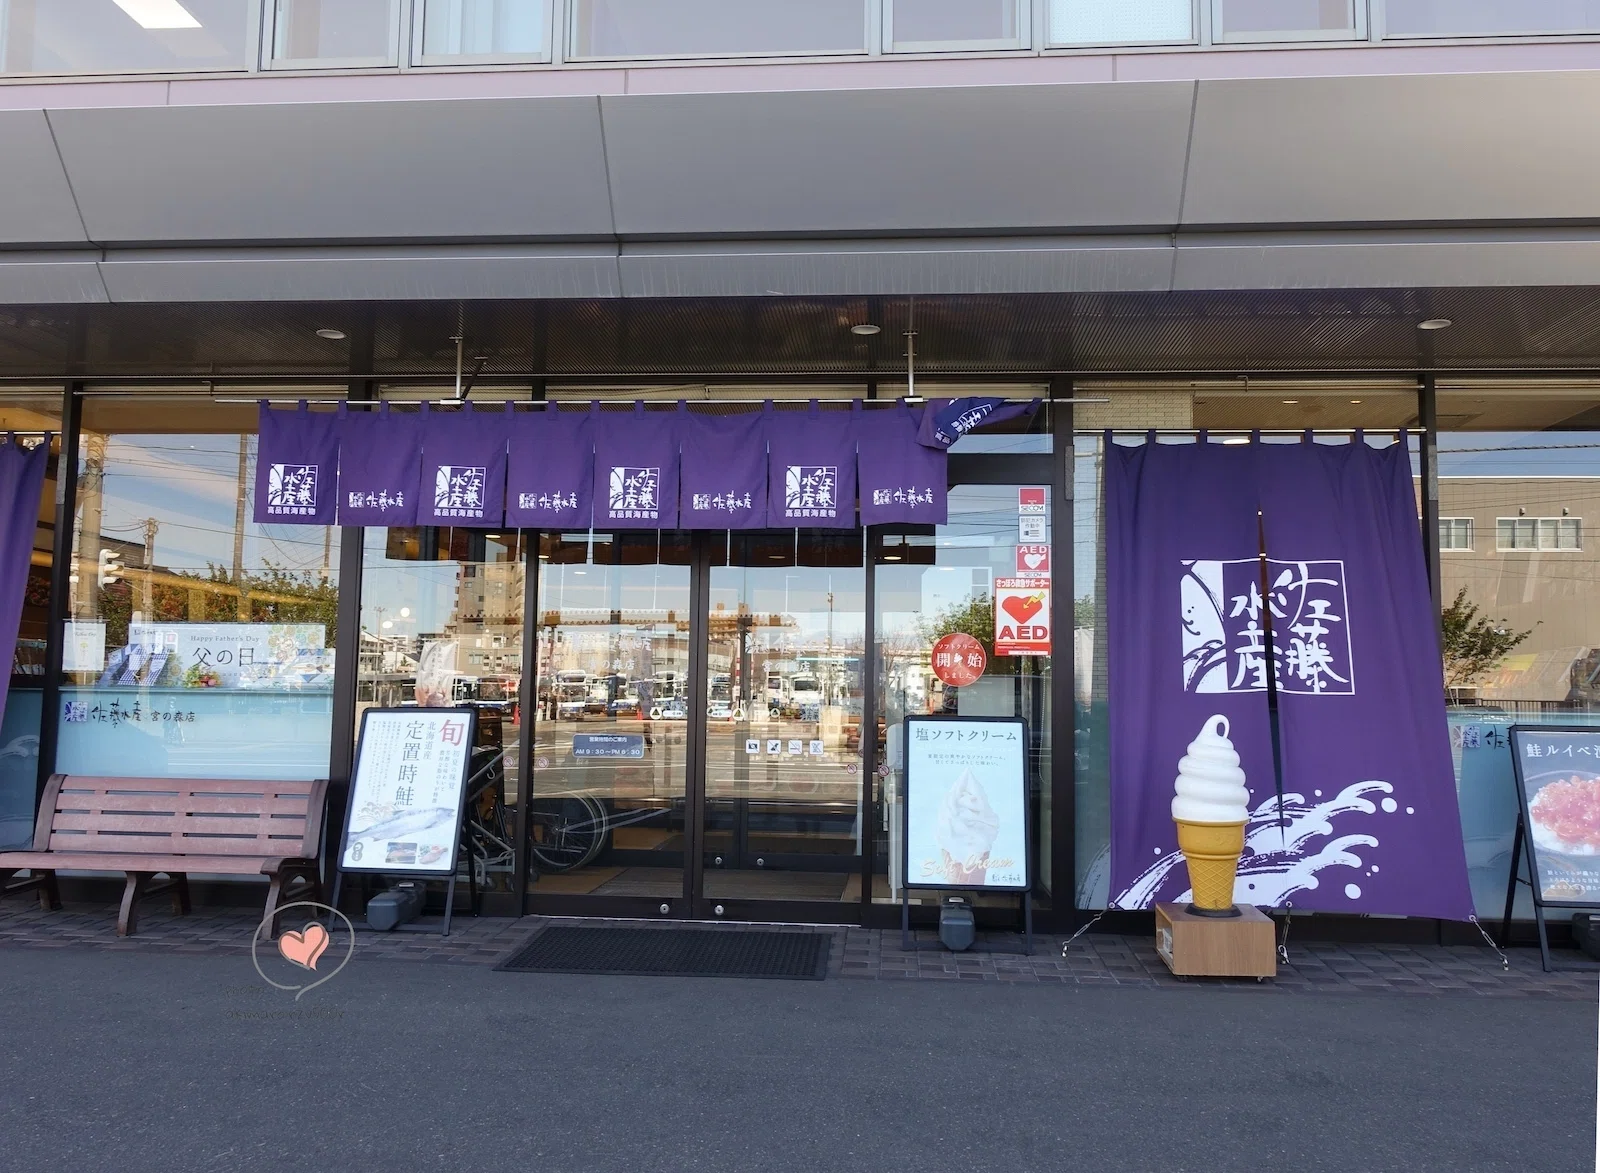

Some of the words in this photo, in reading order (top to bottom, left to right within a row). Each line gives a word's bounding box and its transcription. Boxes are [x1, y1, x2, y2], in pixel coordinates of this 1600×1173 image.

[366, 489, 404, 512] 佐藤水産
[538, 490, 577, 514] 佐藤水産
[713, 490, 752, 514] 佐藤水産
[894, 486, 933, 509] 佐藤水産
[267, 506, 316, 516] 高品質海産物
[434, 508, 484, 519] 高品質海産物
[608, 509, 659, 519] 高品質海産物
[785, 509, 836, 519] 高品質海産物
[1019, 546, 1047, 554] AED
[998, 625, 1048, 640] AED
[192, 647, 254, 667] 父の日
[91, 697, 142, 728] 佐藤水産
[150, 710, 195, 723] 宮の森店
[422, 721, 437, 760] 北海道産
[439, 719, 465, 747] 旬
[915, 727, 1017, 742] 塩ソフトクリーム
[393, 720, 425, 806] 定置時鮭
[919, 857, 955, 880] Soft
[962, 853, 1014, 874] Cream
